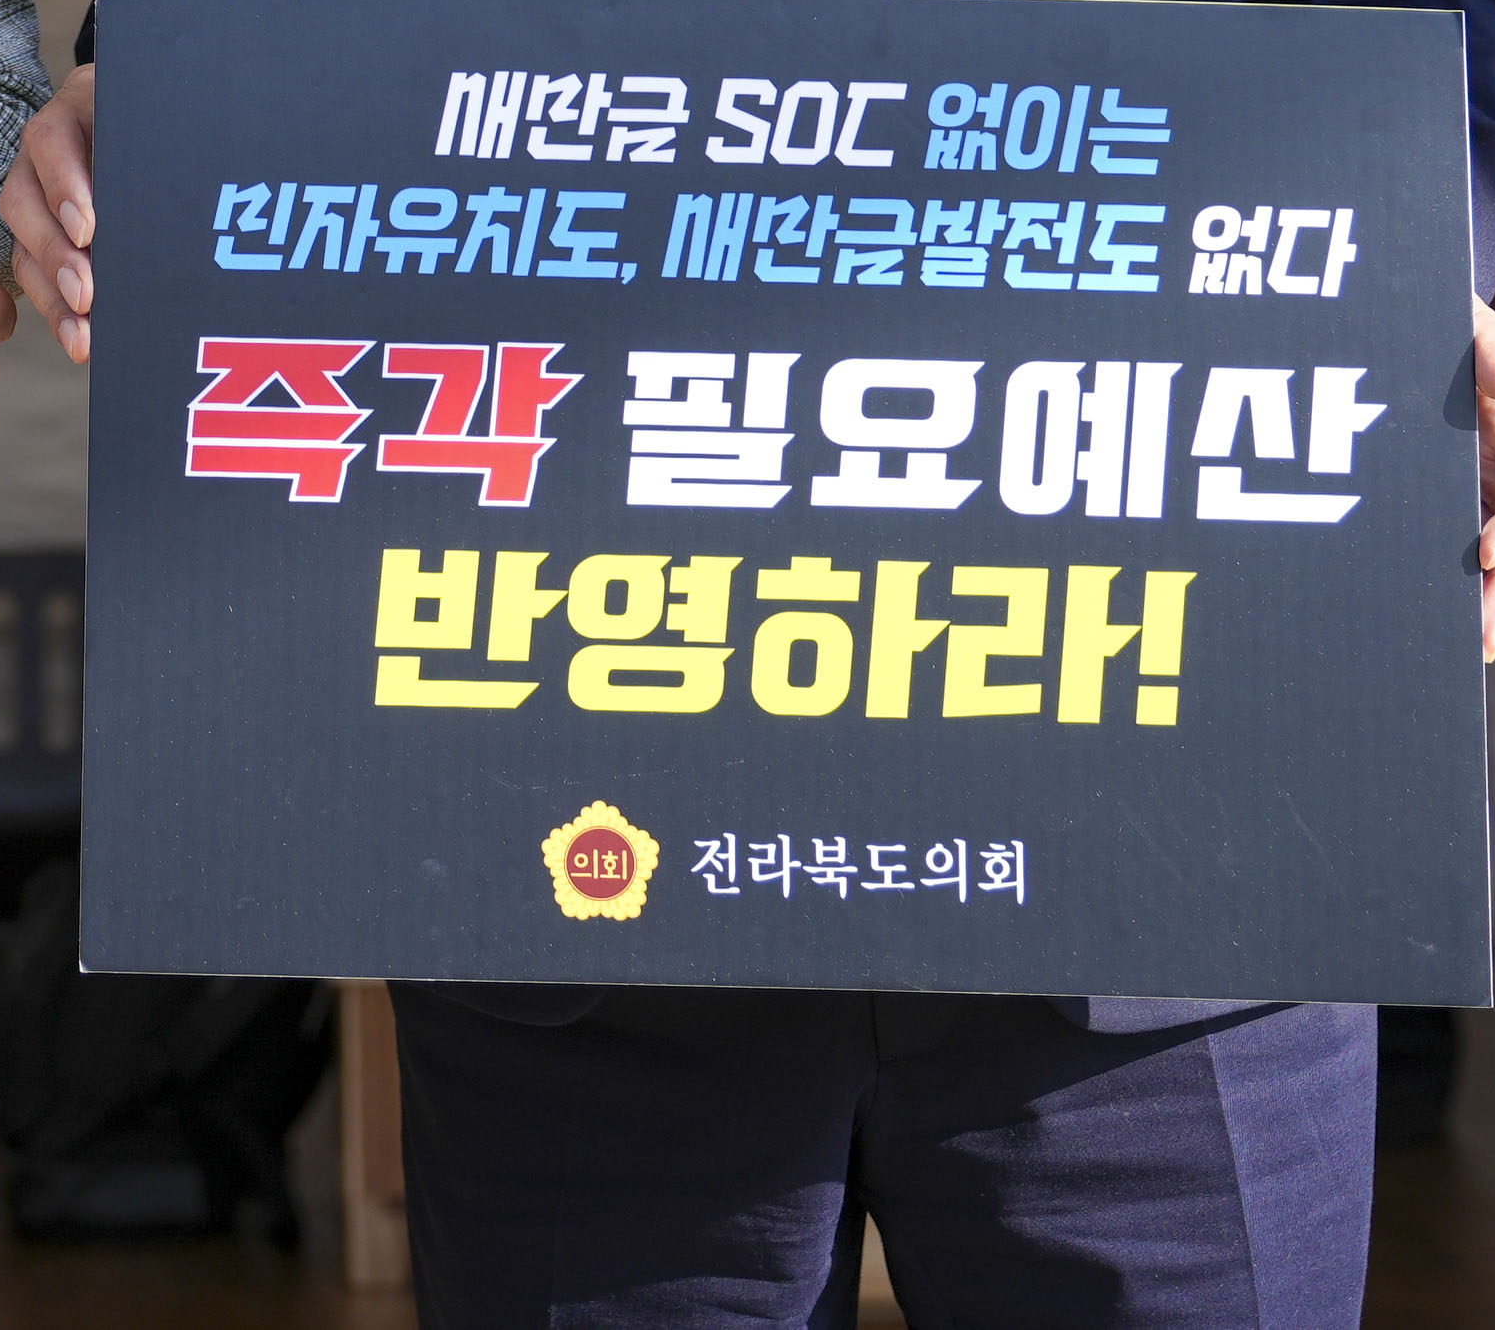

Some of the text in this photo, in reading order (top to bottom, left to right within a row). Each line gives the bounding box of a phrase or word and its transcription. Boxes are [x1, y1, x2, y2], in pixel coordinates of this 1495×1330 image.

[434, 70, 1174, 178] 새만금 SOC 없이는
[211, 181, 1363, 301] 민자유치도, 새만금발전도 없다
[184, 336, 1389, 525] 즉각 필요예산
[373, 548, 1198, 726] 반영하라!
[569, 831, 1026, 907] 의회 전라북도의회
